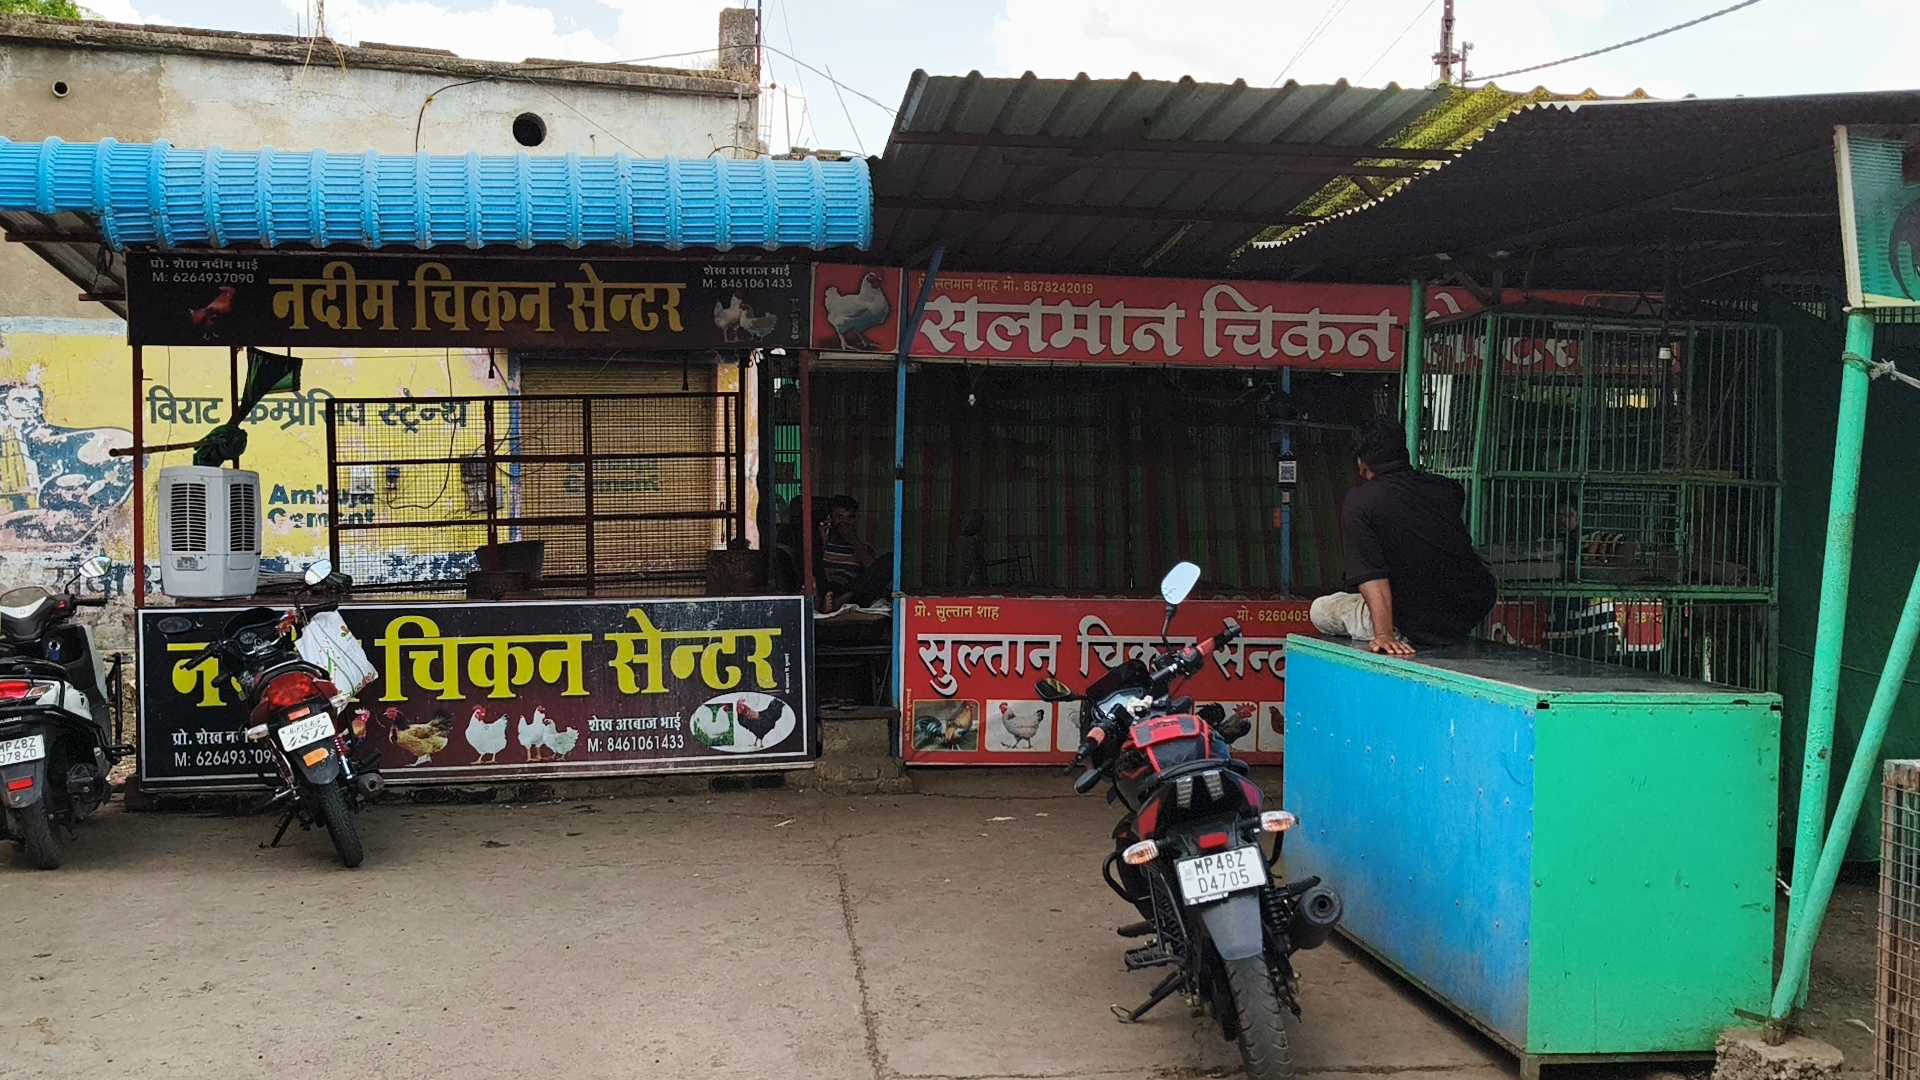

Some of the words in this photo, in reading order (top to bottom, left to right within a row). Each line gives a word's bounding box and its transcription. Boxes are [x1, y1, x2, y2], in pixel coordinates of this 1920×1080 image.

[201, 258, 233, 270] नदीम
[236, 258, 258, 271] भाई
[771, 264, 790, 277] भाई
[152, 272, 168, 282] M:
[173, 272, 255, 283] 6264937090
[702, 279, 717, 289] M:
[720, 279, 793, 289] 8461061433
[976, 279, 998, 294] शाह
[1003, 275, 1019, 292] मो.
[1023, 280, 1094, 295] 8878242019
[268, 261, 400, 331] नदीम
[407, 262, 556, 332] चिकन
[564, 263, 687, 332] सेन्टर
[919, 295, 1186, 357] सलमान
[1199, 284, 1398, 362] चिकन
[145, 385, 223, 425] विराट
[914, 600, 931, 618] प्रो.
[935, 605, 974, 623] सुल्तान
[976, 605, 1000, 621] शाह
[1237, 605, 1253, 621] मो.
[1258, 610, 1309, 622] 6260405
[374, 615, 593, 703] चिकन
[604, 607, 782, 695] सेन्टर
[917, 633, 1062, 697] सुल्तान
[1077, 614, 1198, 679] चिक
[616, 717, 658, 731] अरबाज
[660, 711, 682, 731] भाई
[171, 729, 193, 746] प्रो.
[587, 738, 603, 752] M:
[607, 734, 685, 752] 8461061433
[174, 752, 191, 767] M:
[1193, 851, 1246, 876] MP48Z
